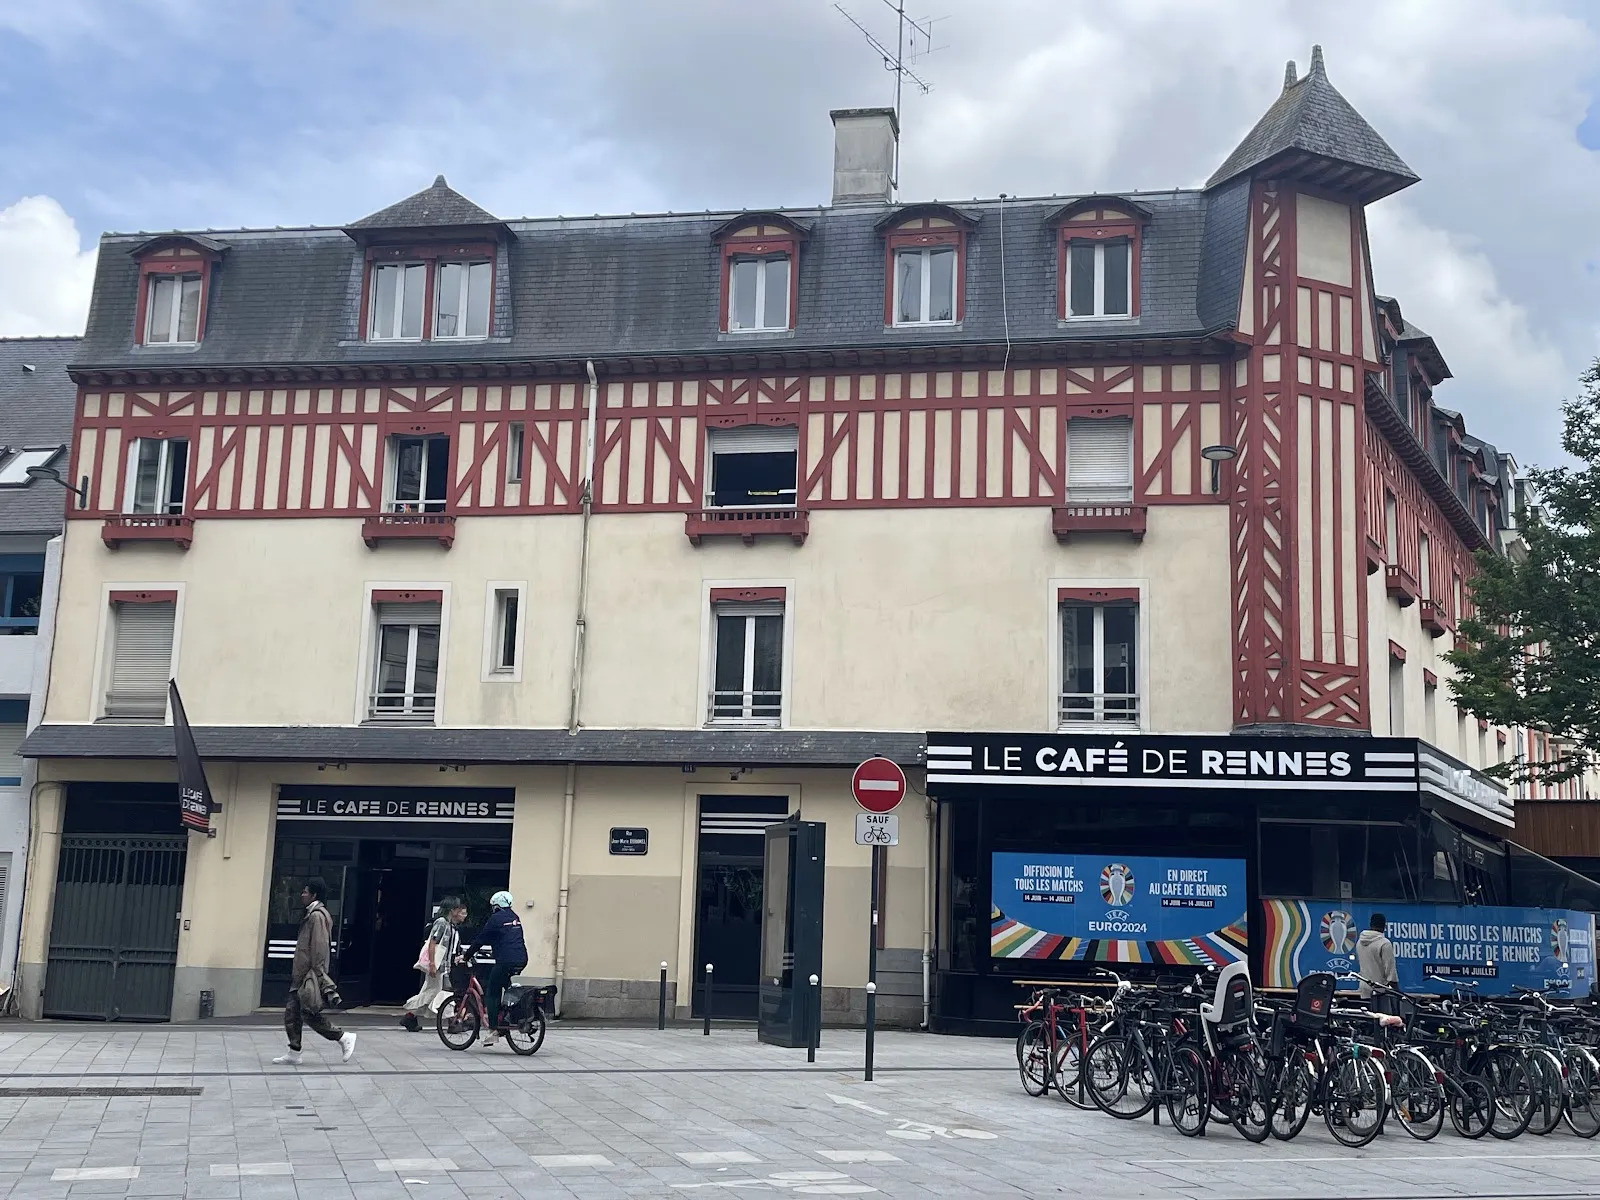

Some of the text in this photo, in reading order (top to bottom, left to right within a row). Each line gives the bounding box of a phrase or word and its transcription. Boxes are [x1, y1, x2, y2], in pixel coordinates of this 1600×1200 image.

[983, 741, 1352, 777] LE CAFÉ DE RENNES
[306, 800, 489, 816] LE CAFE DE RENNES
[866, 815, 890, 824] SAUF
[1023, 864, 1075, 879] DIFFUSION DE
[1167, 869, 1208, 883] EN DIRECT
[1014, 878, 1084, 893] TOUS LES MATCHS
[1148, 881, 1228, 897] AU CAFÉ DE RENNES
[1106, 911, 1128, 920] UEFA
[1088, 920, 1148, 933] EURO2024
[1384, 921, 1543, 944] FUSION DE TOUS LES MATCHS
[1393, 940, 1541, 963] DIRECT AU CAFÉ DE RENNES
[1327, 960, 1350, 969] UEFA
[1425, 965, 1433, 974] 14
[1462, 967, 1470, 976] 14
[1471, 967, 1497, 977] JUILLET
